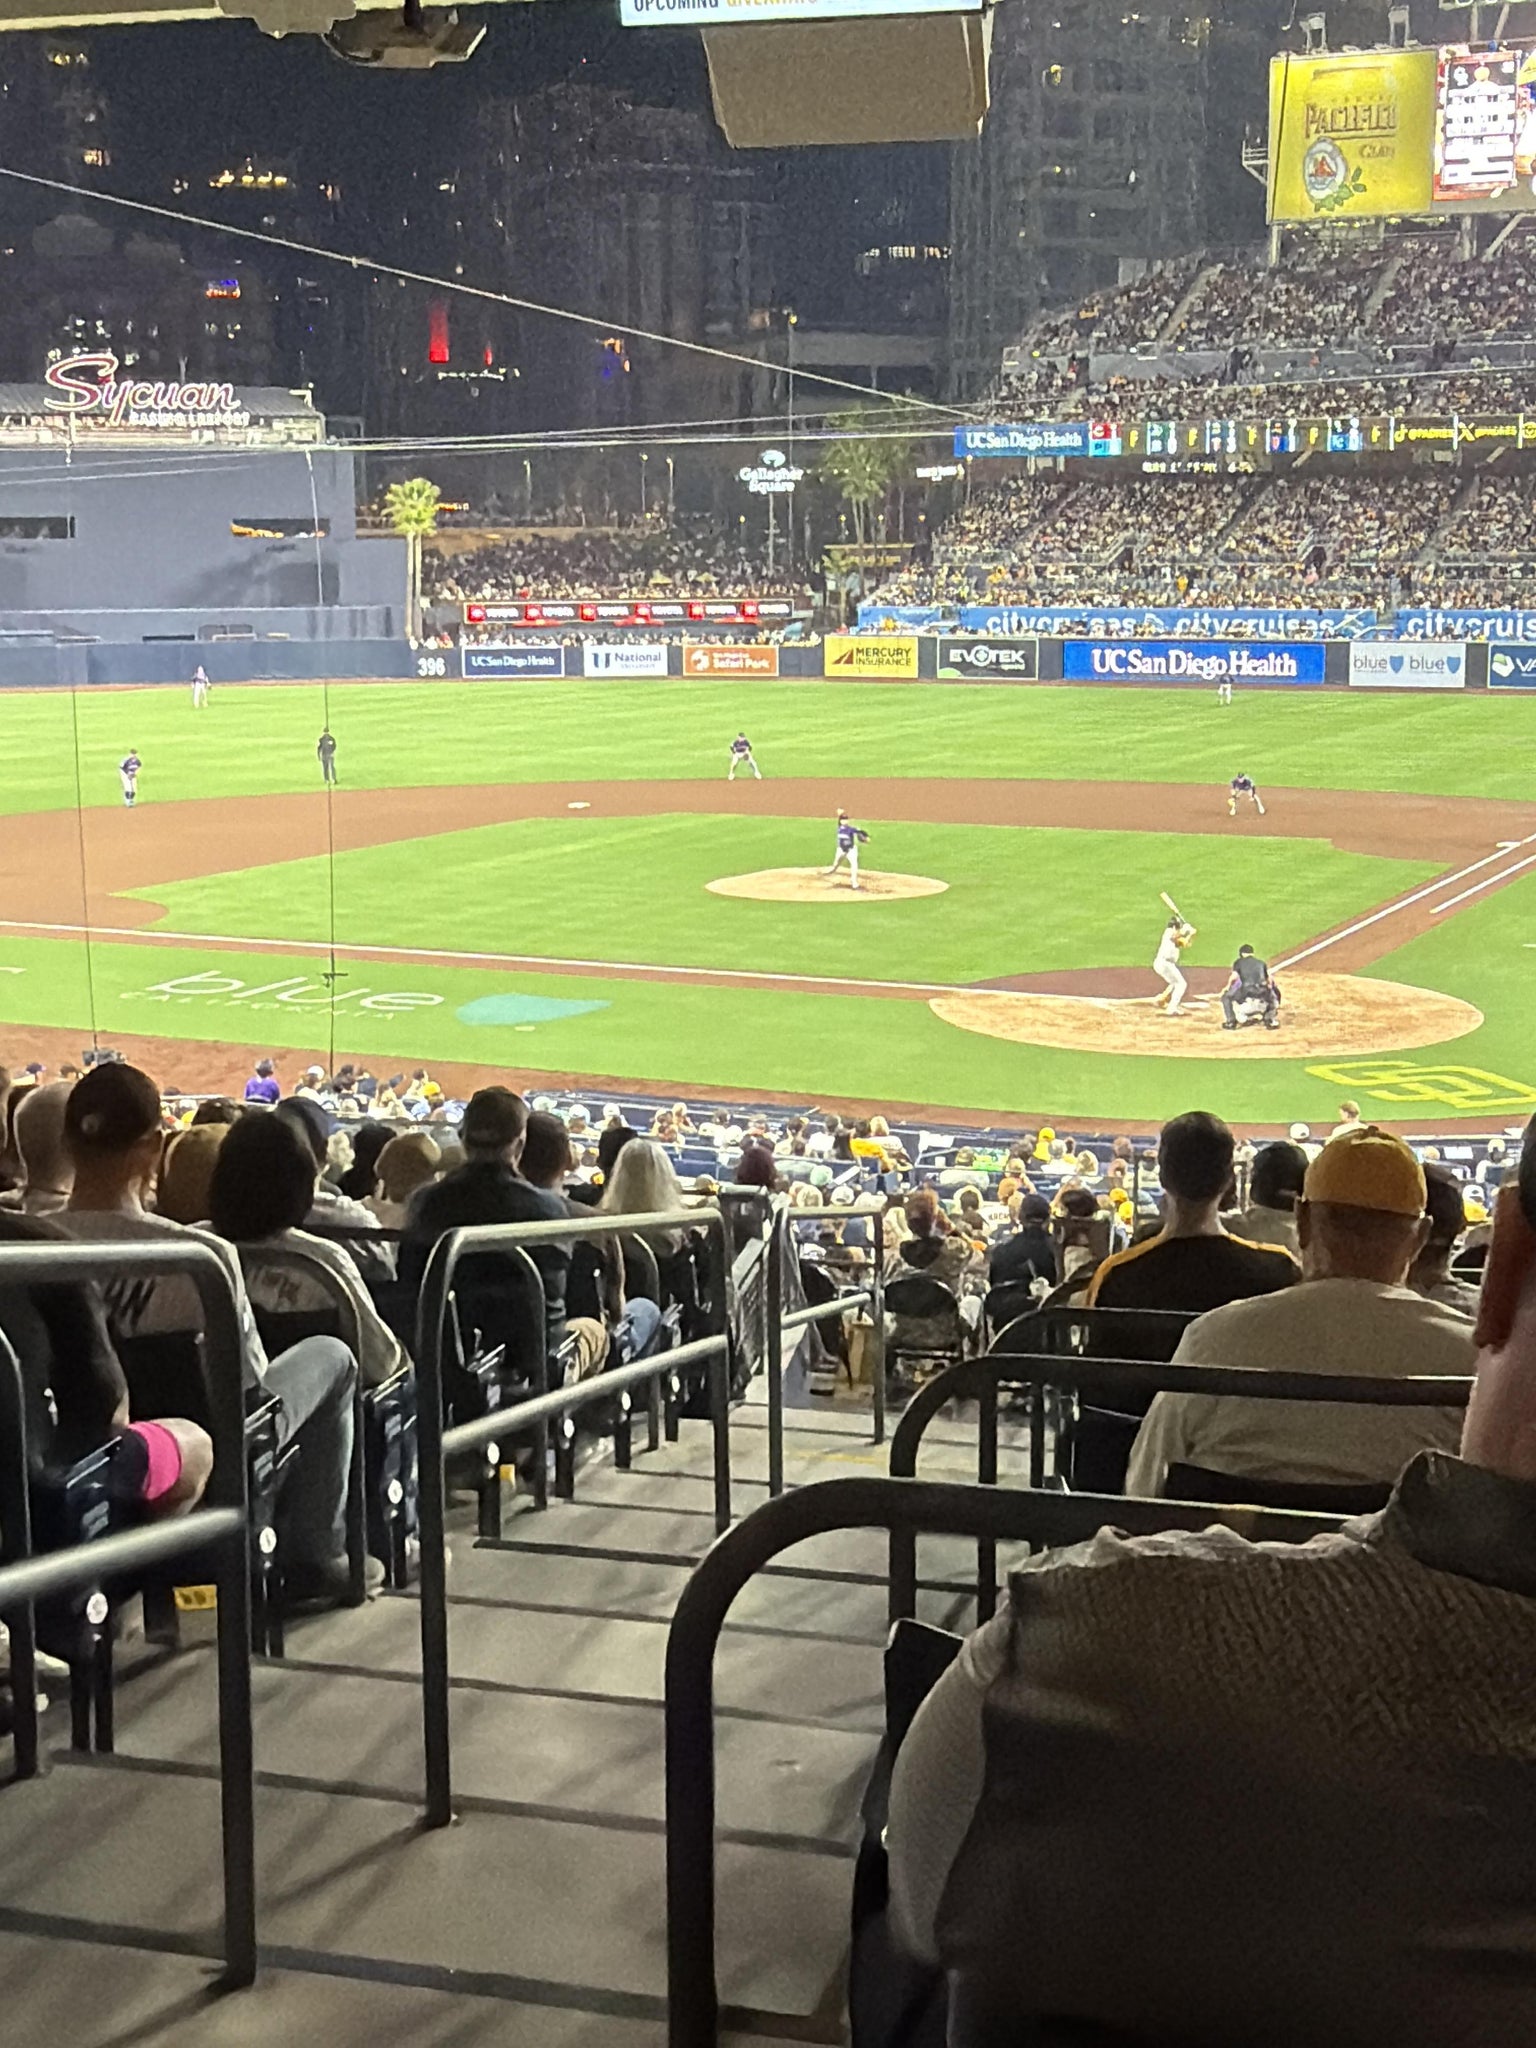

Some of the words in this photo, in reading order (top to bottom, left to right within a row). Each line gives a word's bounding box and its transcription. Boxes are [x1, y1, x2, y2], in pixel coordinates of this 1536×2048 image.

[44, 352, 242, 427] Sycuan
[614, 652, 662, 662] National
[855, 647, 912, 658] MERCURY
[949, 645, 1025, 667] EVOTEK
[417, 657, 446, 677] 396
[855, 657, 912, 667] INSURANCE
[1091, 649, 1127, 673] UC
[1127, 649, 1167, 674] San
[1168, 649, 1228, 680] Diego
[1228, 650, 1298, 676] Health
[1353, 654, 1388, 669] blue
[1409, 655, 1445, 670] blue
[146, 970, 445, 1010] blue
